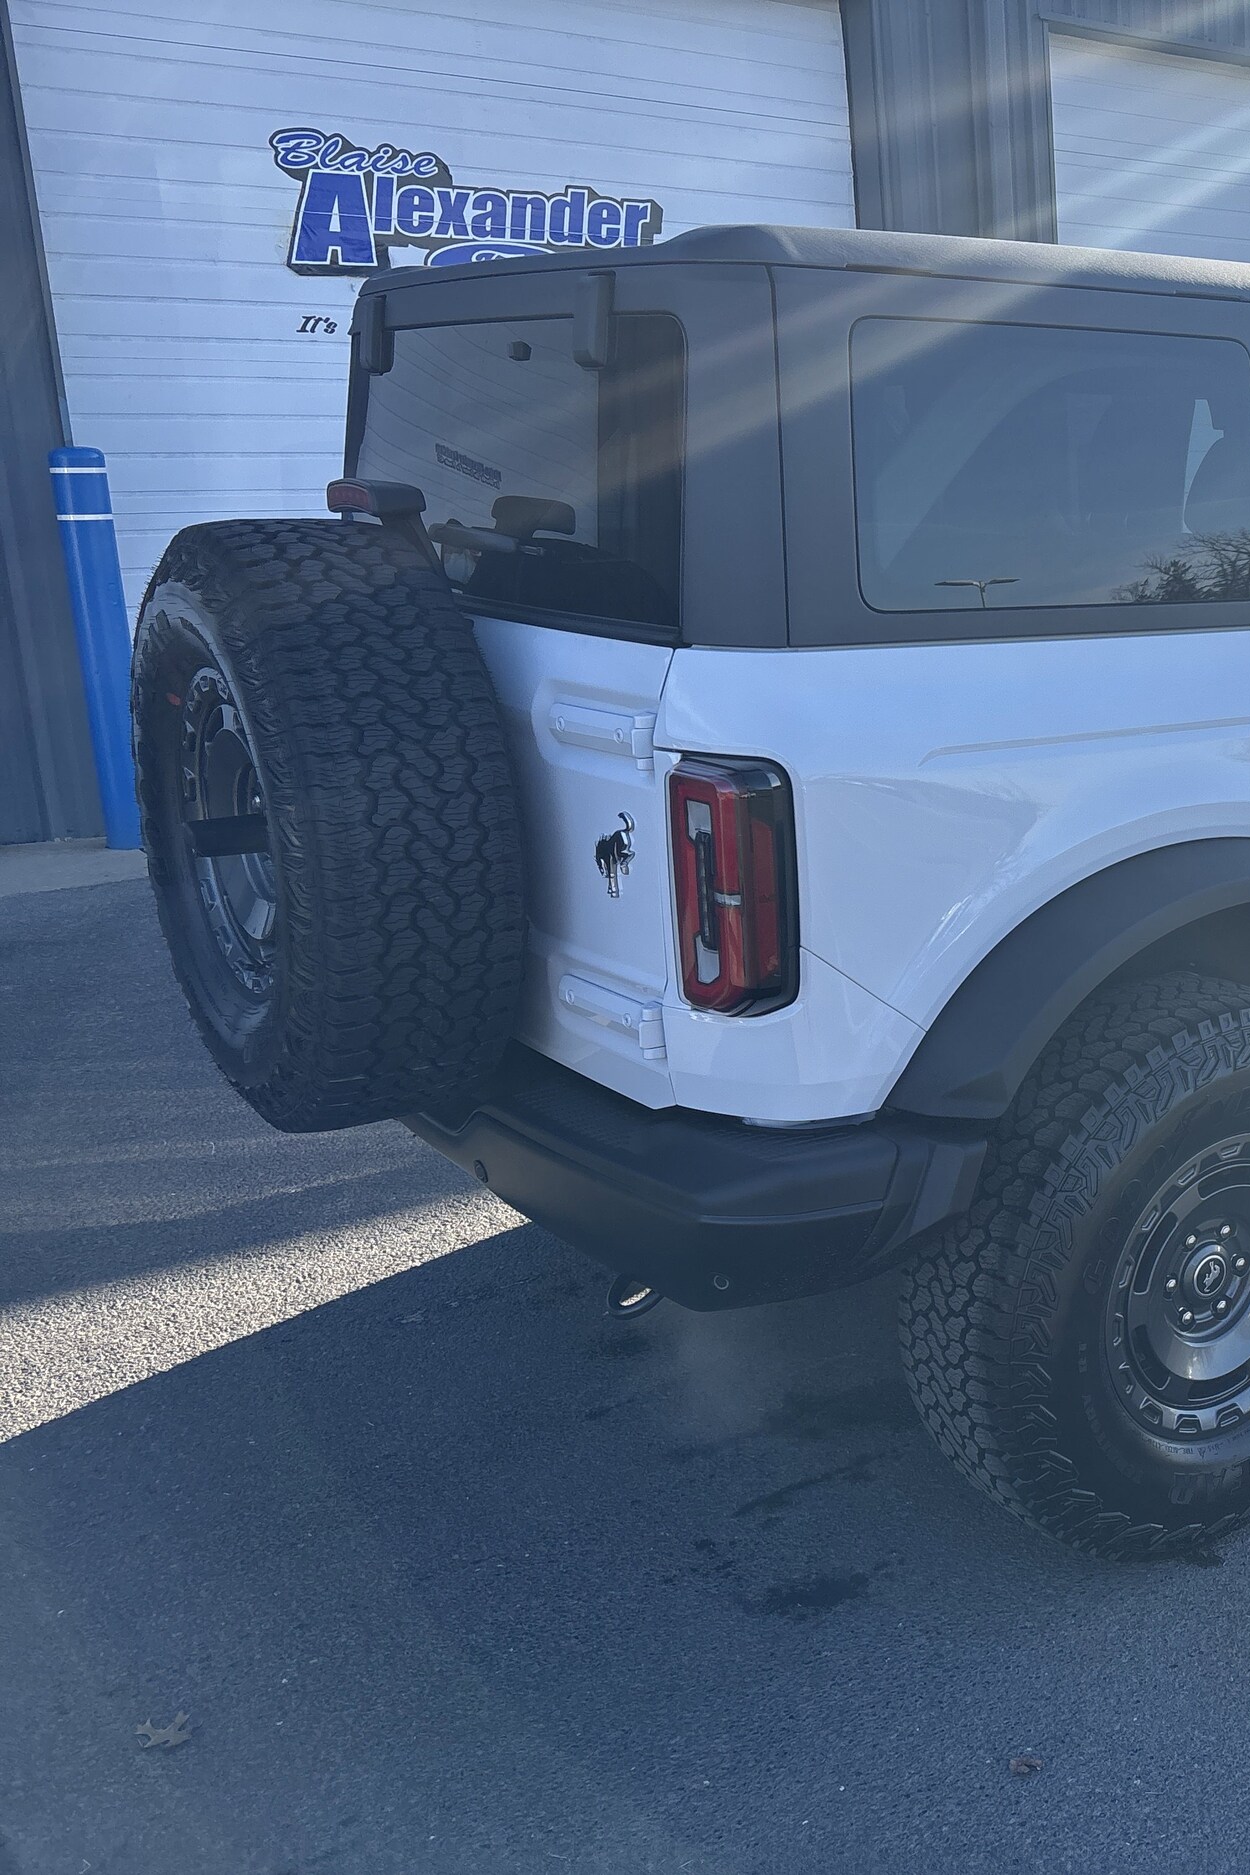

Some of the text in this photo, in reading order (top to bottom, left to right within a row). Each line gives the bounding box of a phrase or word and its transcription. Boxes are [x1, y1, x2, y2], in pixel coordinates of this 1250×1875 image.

[274, 130, 439, 178] Blaise
[291, 168, 652, 268] Alexander
[296, 315, 338, 335] It's
